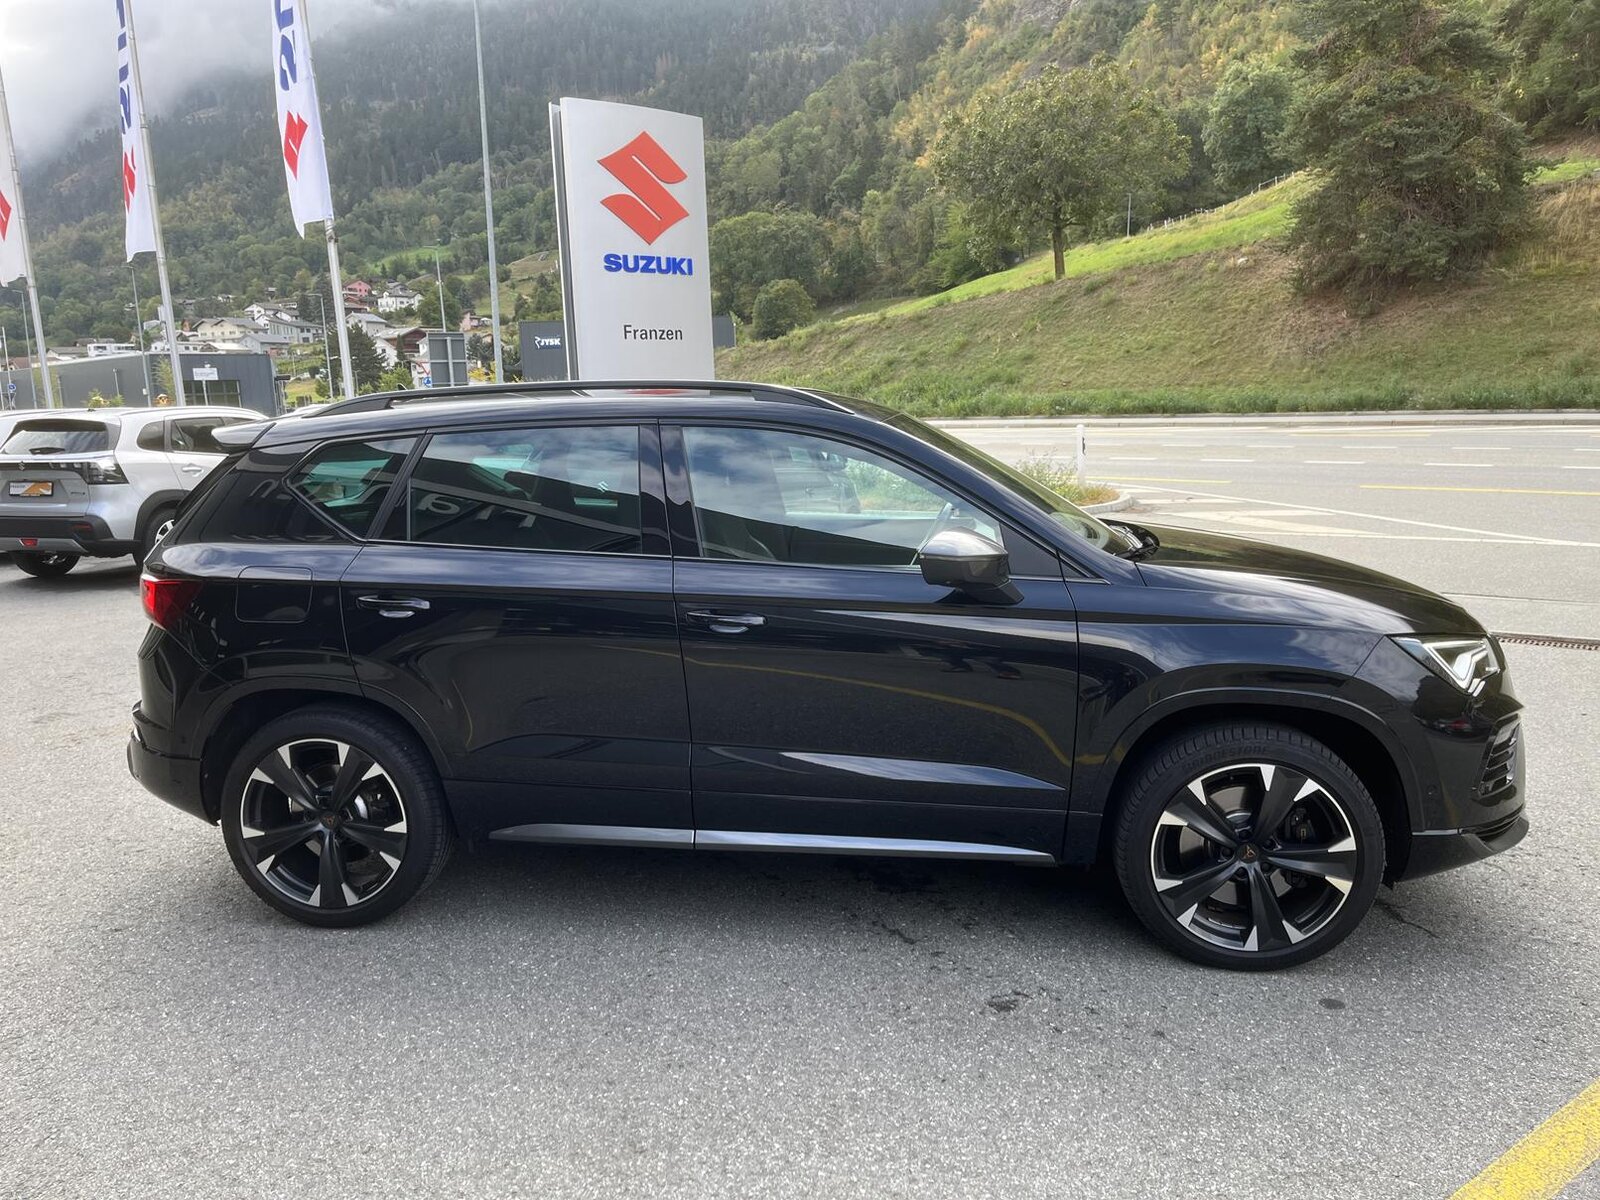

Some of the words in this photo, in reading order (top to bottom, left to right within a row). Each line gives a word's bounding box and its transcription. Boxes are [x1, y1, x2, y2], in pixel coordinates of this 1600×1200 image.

[603, 253, 694, 276] SUZUKI
[623, 324, 683, 341] Franzen
[540, 338, 561, 346] JYSK
